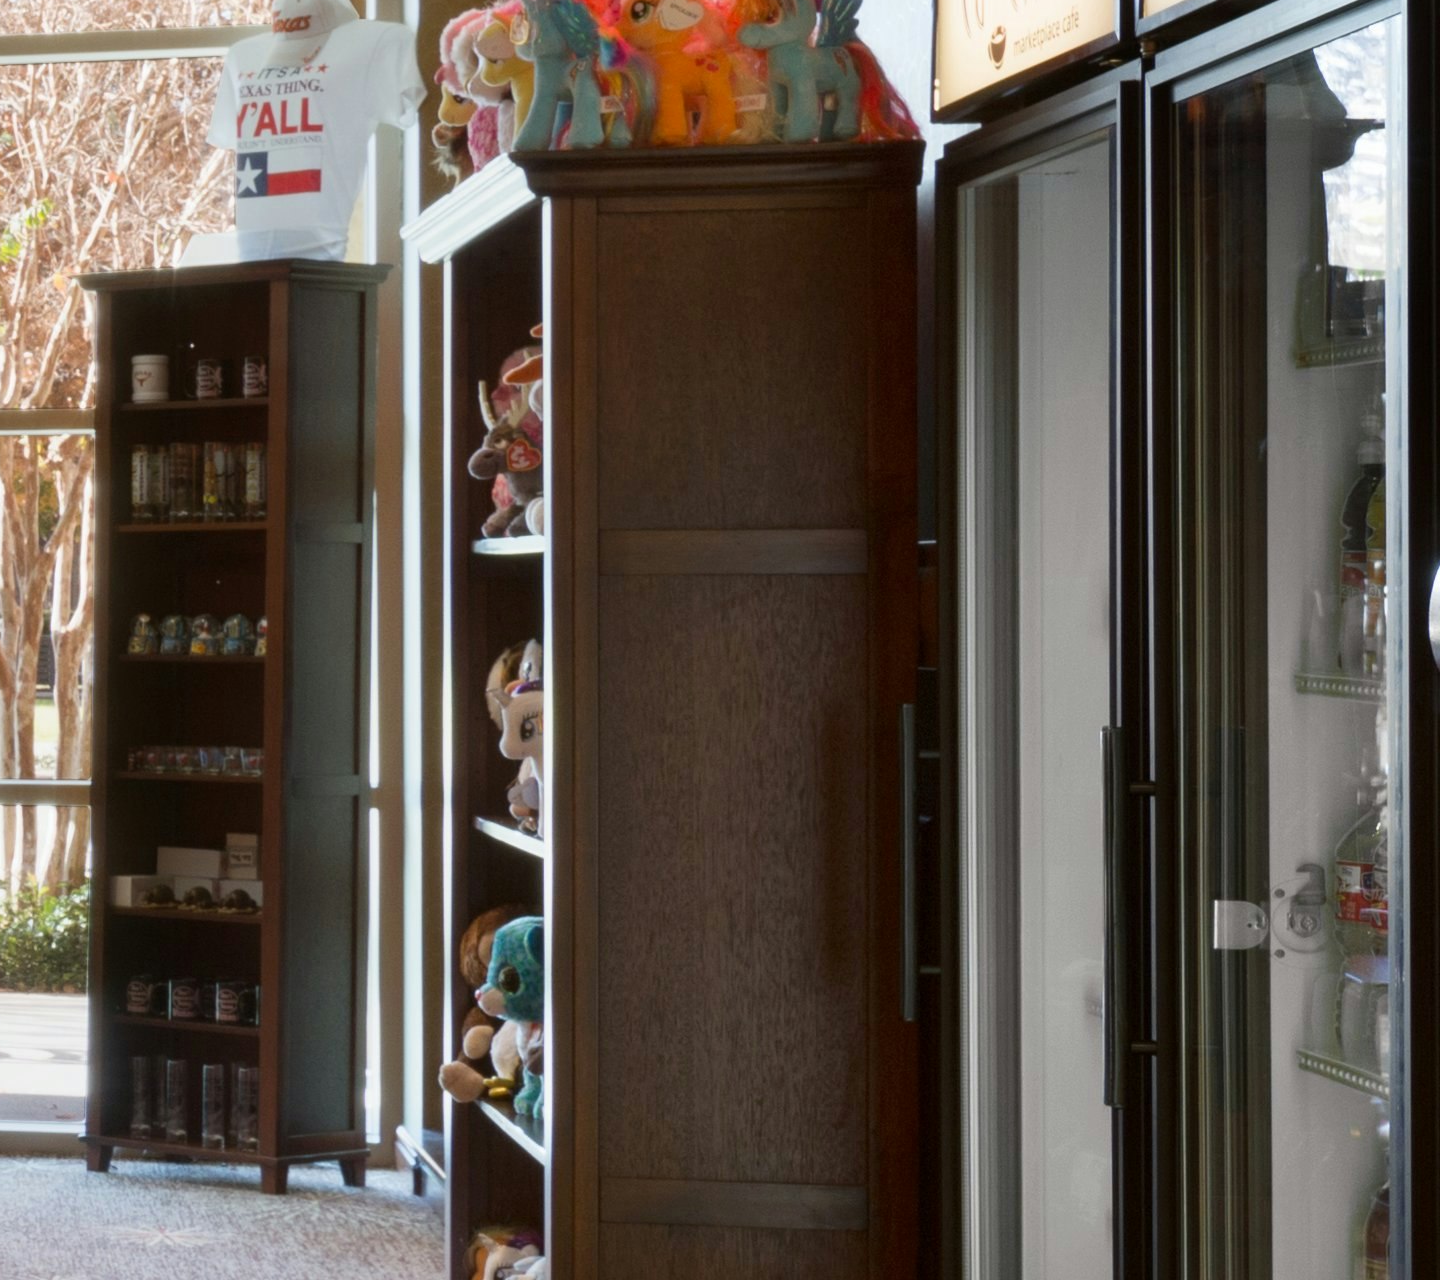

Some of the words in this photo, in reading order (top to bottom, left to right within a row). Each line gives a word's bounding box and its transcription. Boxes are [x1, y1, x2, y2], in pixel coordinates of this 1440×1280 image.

[1012, 15, 1061, 58] marketplace
[1063, 6, 1080, 35] café
[239, 83, 272, 99] EXAS
[275, 78, 325, 97] THING.
[257, 66, 288, 80] IT'S
[289, 66, 301, 76] A
[237, 96, 324, 139] Y'ALL
